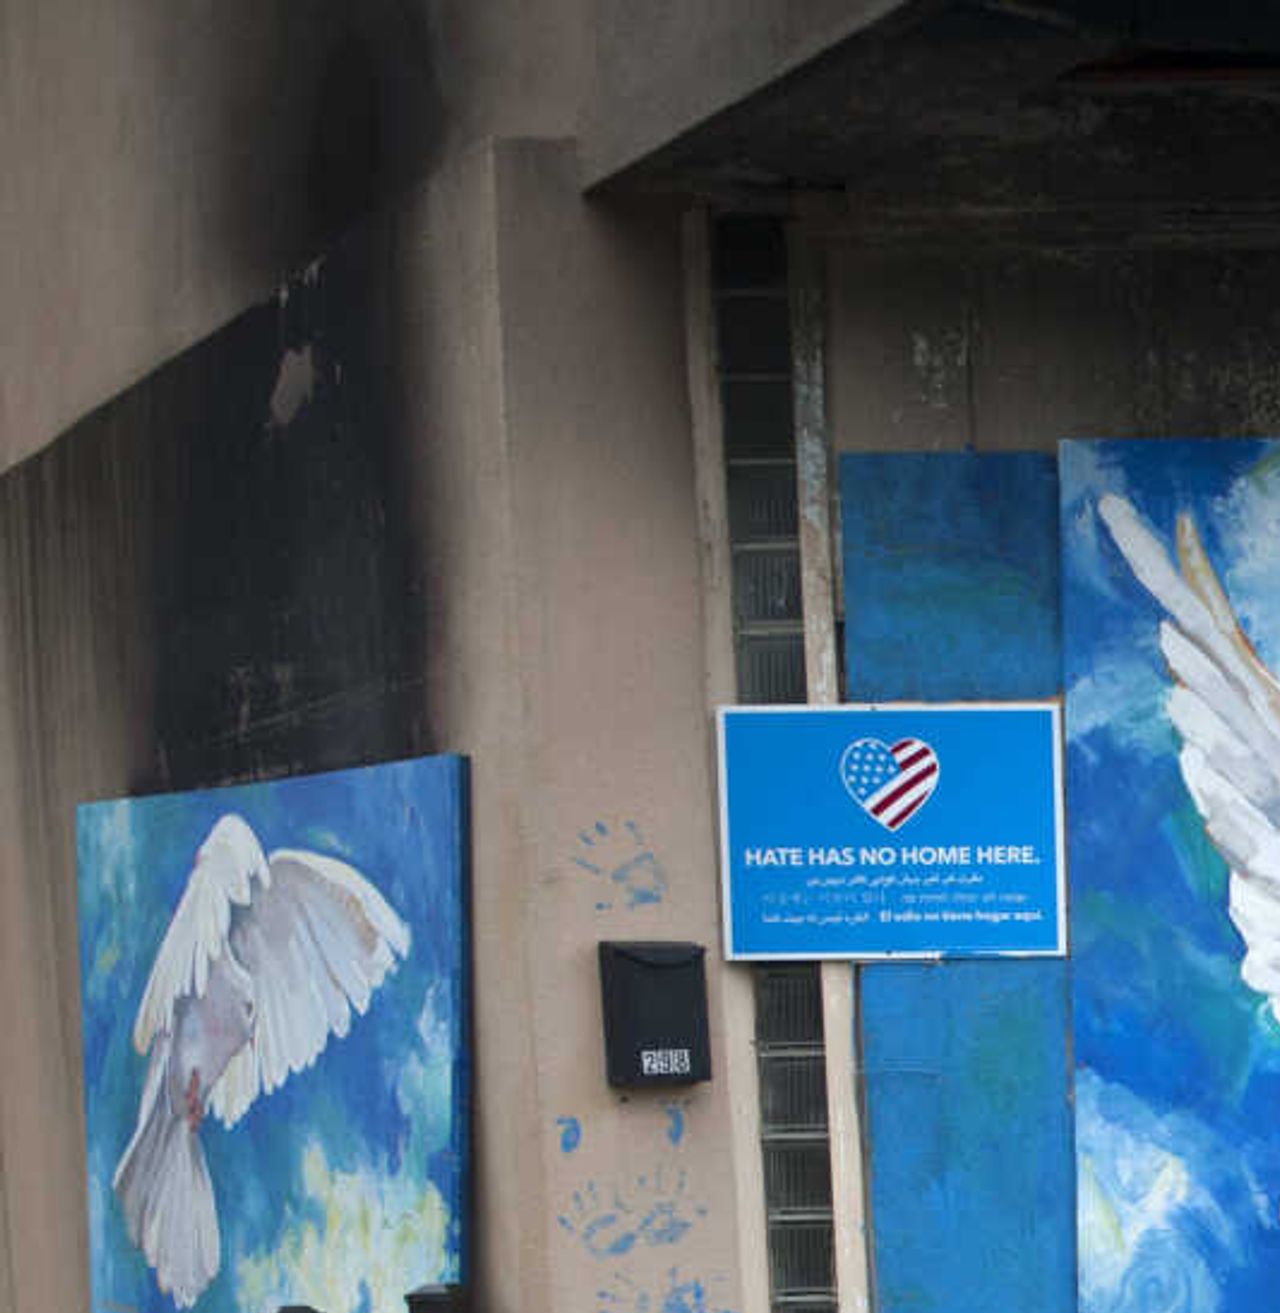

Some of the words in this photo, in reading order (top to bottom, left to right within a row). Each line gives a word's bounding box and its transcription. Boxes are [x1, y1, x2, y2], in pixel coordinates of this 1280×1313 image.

[744, 847, 803, 866] HATE
[808, 846, 856, 866] HAS
[859, 847, 897, 865] NO
[901, 846, 971, 865] HOME
[976, 845, 1041, 865] HERE.
